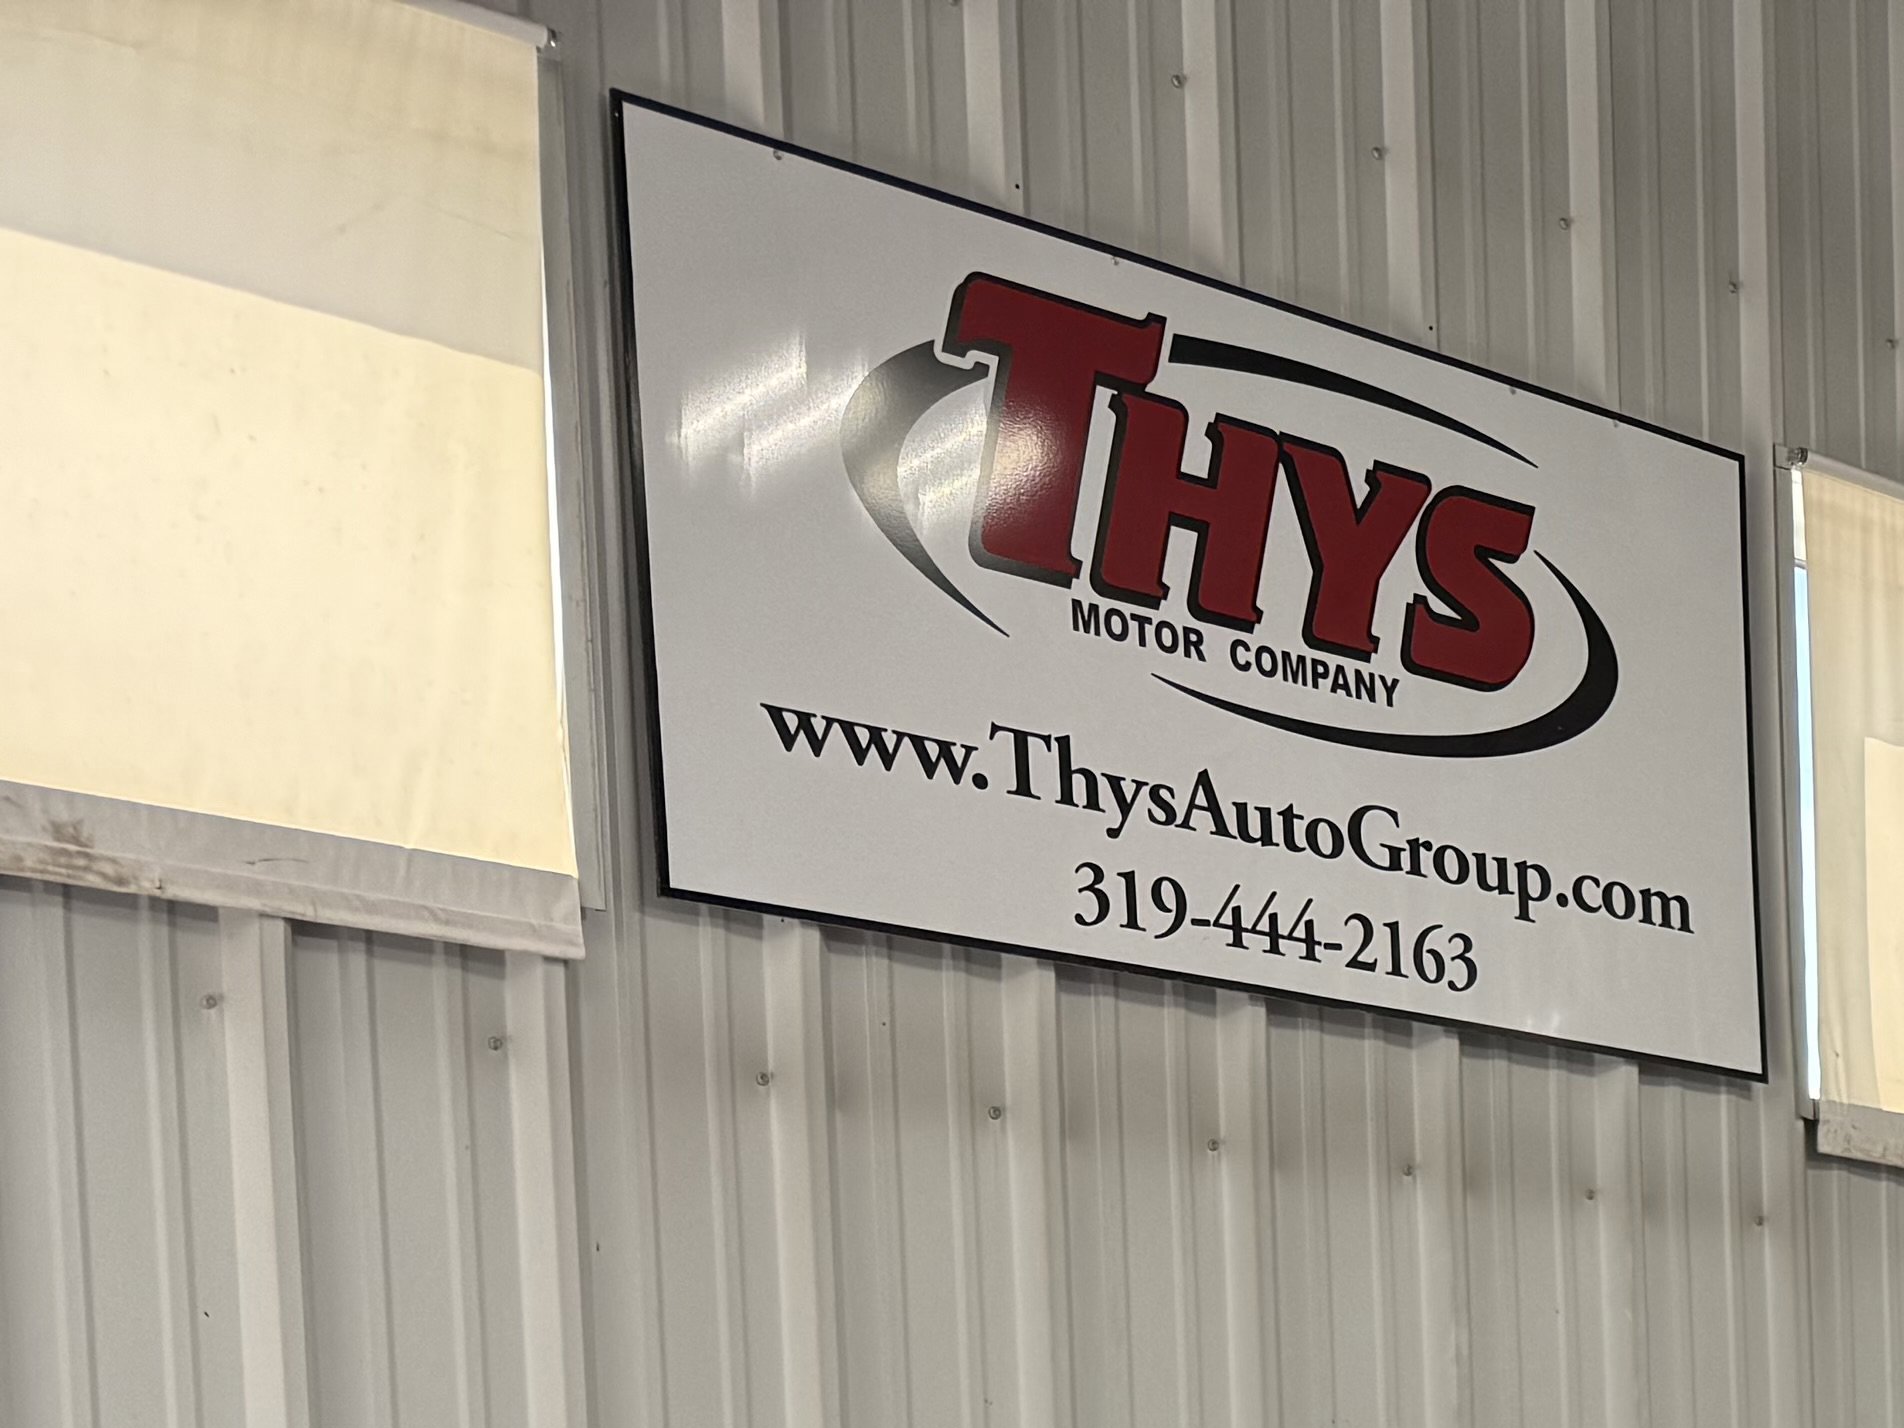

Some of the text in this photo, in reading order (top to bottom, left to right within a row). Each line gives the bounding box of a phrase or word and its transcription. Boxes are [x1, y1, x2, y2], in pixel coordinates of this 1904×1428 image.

[944, 270, 1536, 692] THYS
[1070, 598, 1401, 708] MOTOR COMPANY
[760, 702, 1694, 933] www.ThysAutoGroup.com
[1073, 861, 1480, 992] 319-444-2163
